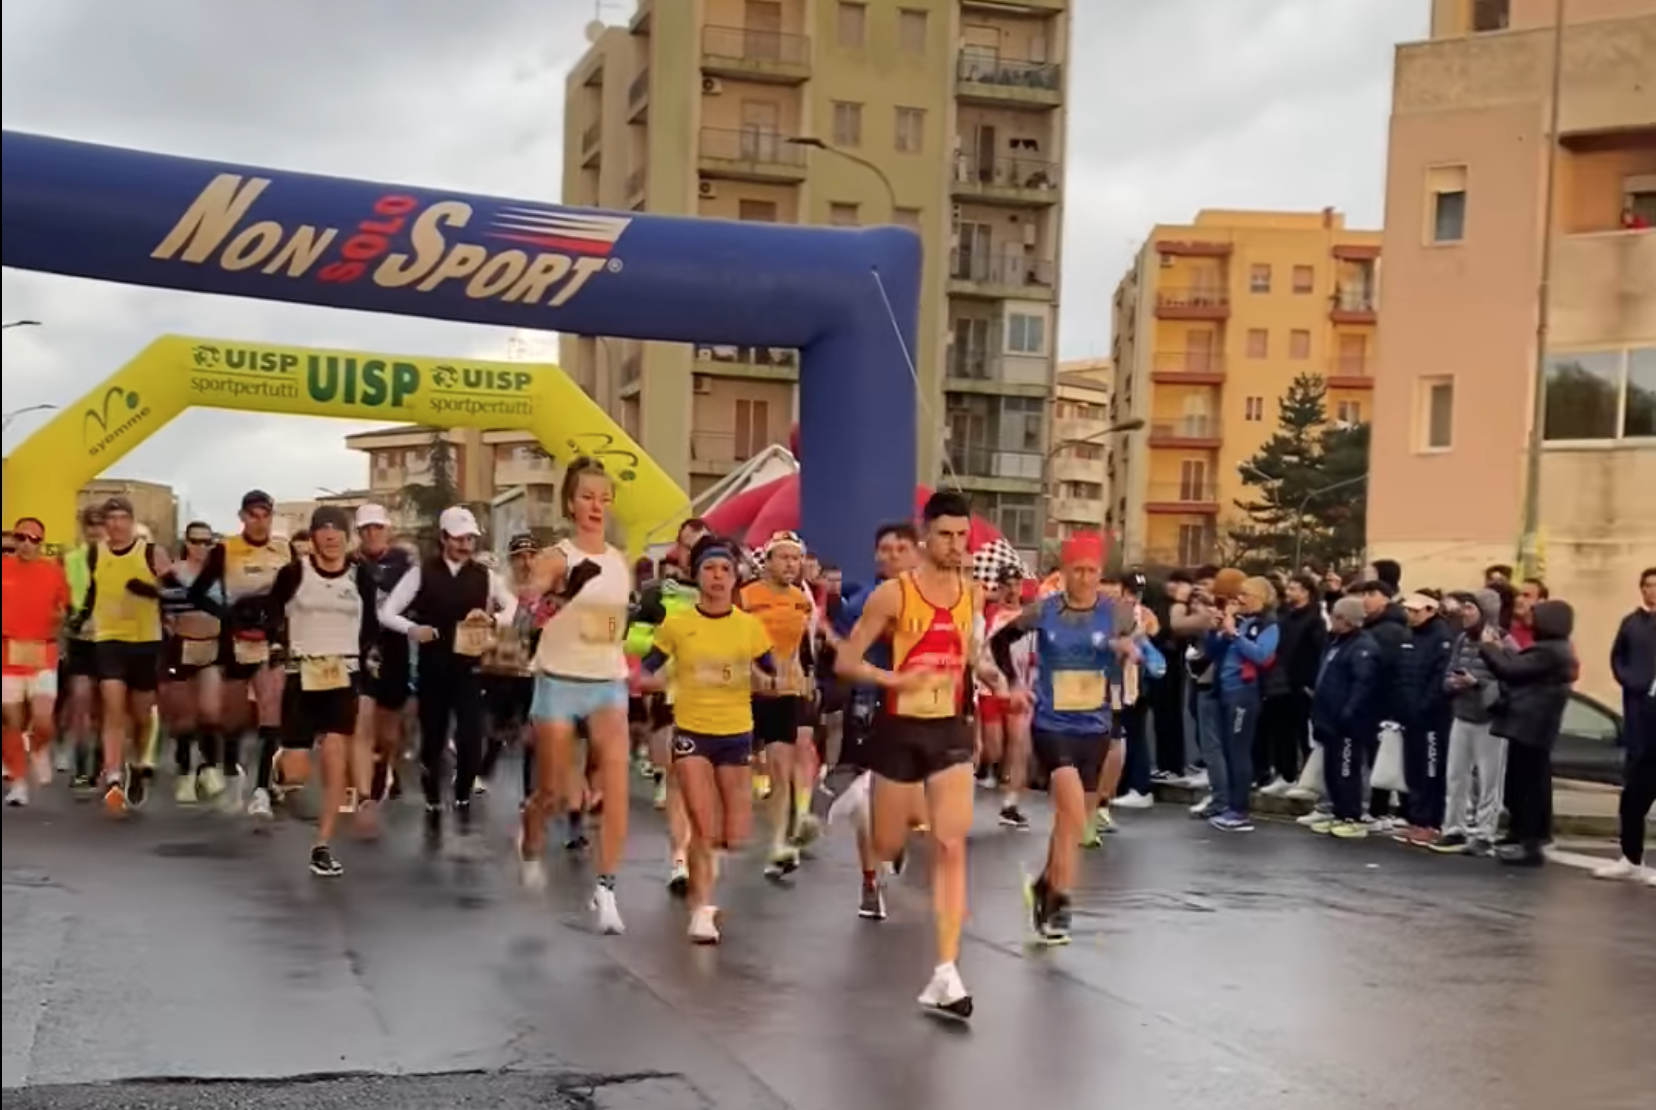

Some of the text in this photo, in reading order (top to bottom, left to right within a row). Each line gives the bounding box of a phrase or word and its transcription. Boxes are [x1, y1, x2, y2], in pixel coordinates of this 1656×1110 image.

[151, 172, 607, 307] NON SOLO SPORT
[225, 348, 299, 373] UISP
[191, 376, 299, 398] sportpertutti
[307, 354, 420, 407] UISP
[463, 368, 532, 391] UISP
[429, 397, 533, 416] sportpertutti
